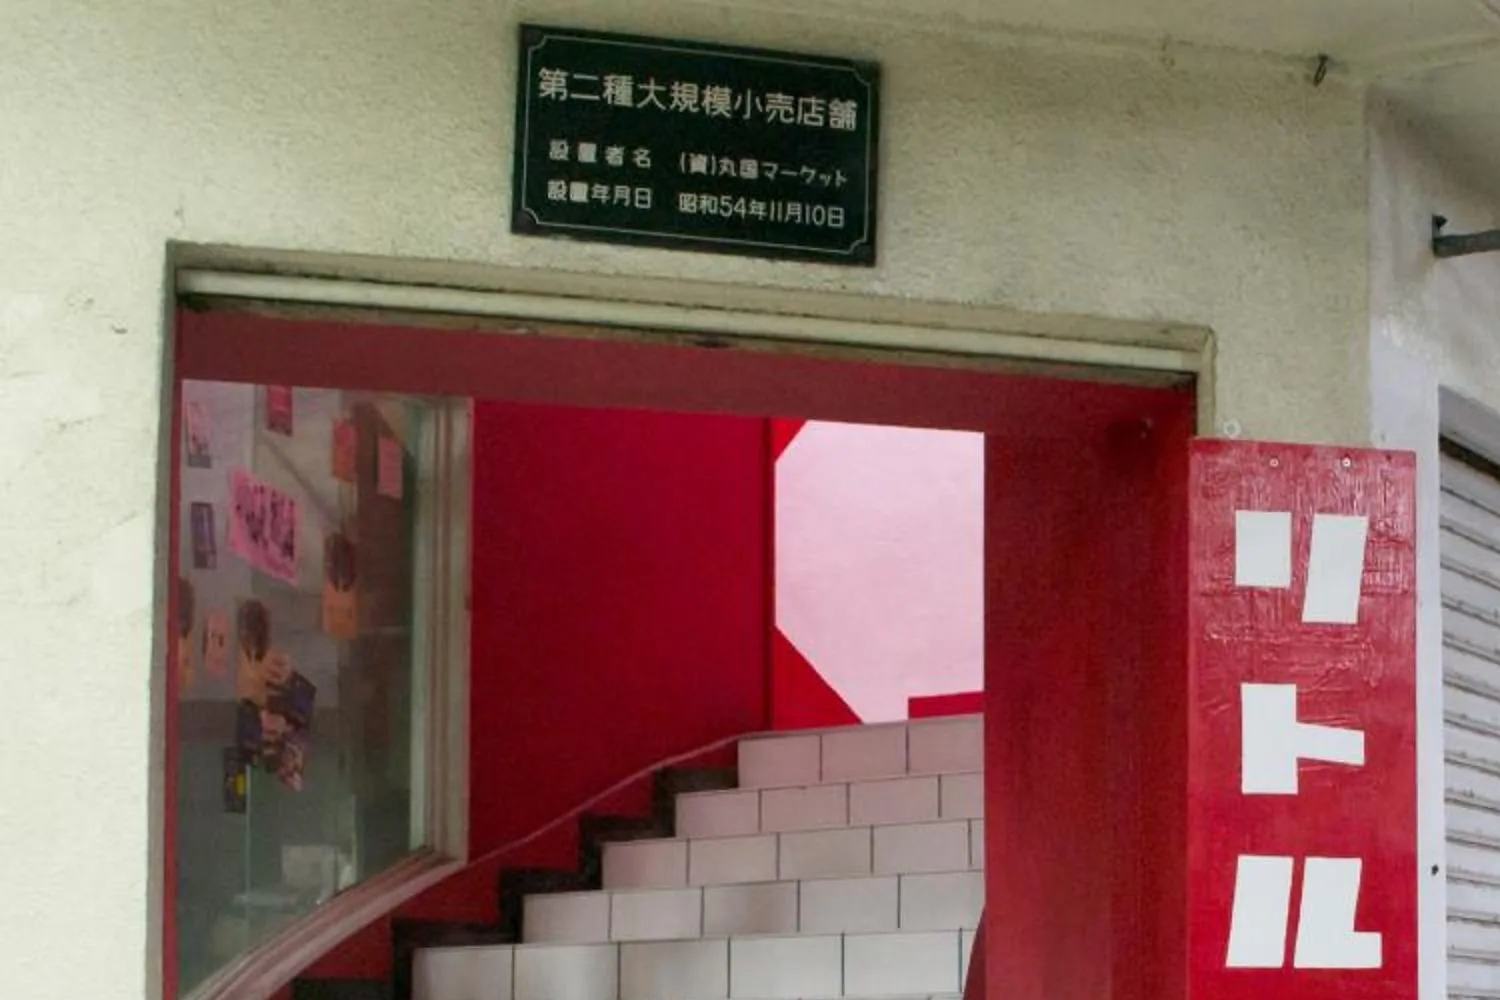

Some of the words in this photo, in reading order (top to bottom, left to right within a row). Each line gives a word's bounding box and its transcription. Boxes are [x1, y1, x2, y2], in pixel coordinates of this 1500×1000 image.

[538, 67, 858, 131] 第二種大規模小売店舗
